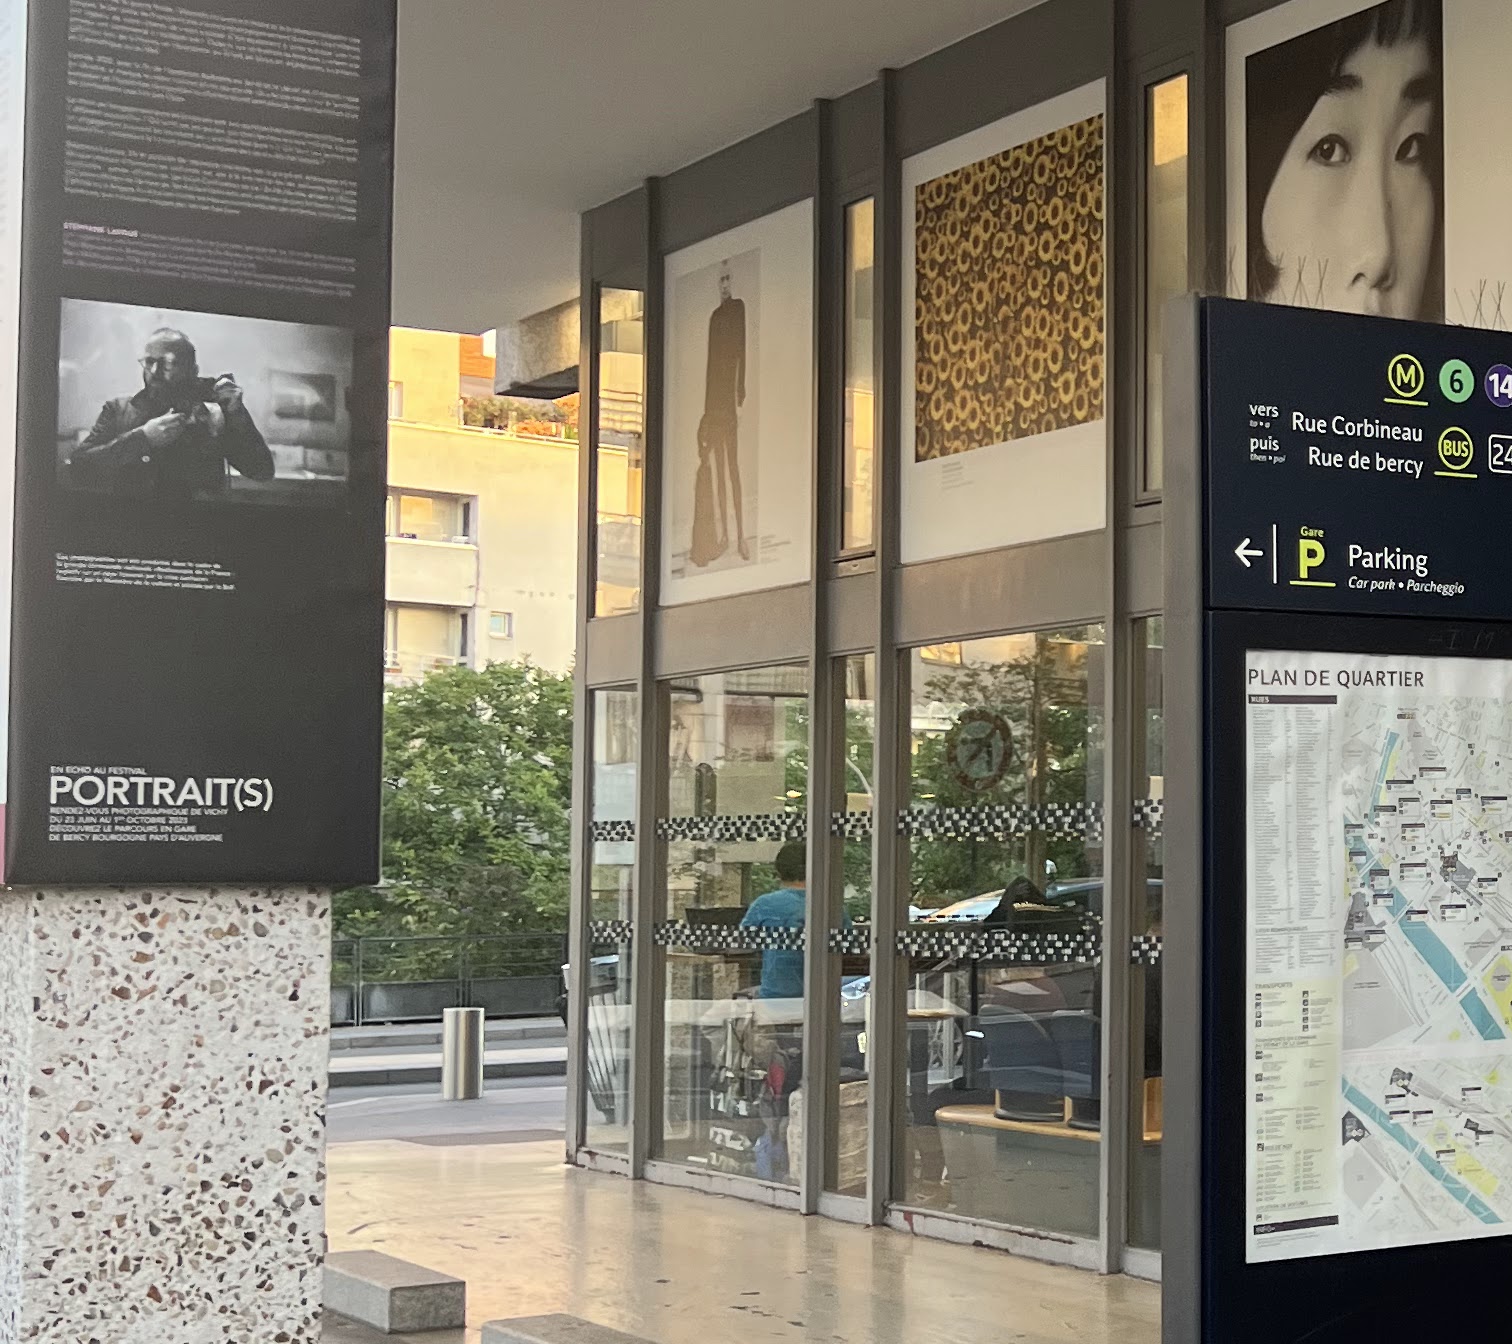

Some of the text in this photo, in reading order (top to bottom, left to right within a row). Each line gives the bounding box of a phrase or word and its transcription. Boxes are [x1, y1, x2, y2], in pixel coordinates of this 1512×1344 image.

[1249, 403, 1279, 418] vers
[1292, 411, 1423, 442] Rue Corbineau
[1249, 436, 1280, 453] puis
[1443, 439, 1469, 458] BUS
[1308, 446, 1424, 479] Rue de bercy
[1300, 526, 1324, 538] Gare
[1348, 544, 1428, 578] Parking
[1348, 576, 1465, 597] Car park Parcheggio
[1249, 669, 1425, 690] PLAN DE QUARTIER
[50, 775, 274, 812] PORTRAIT(S)
